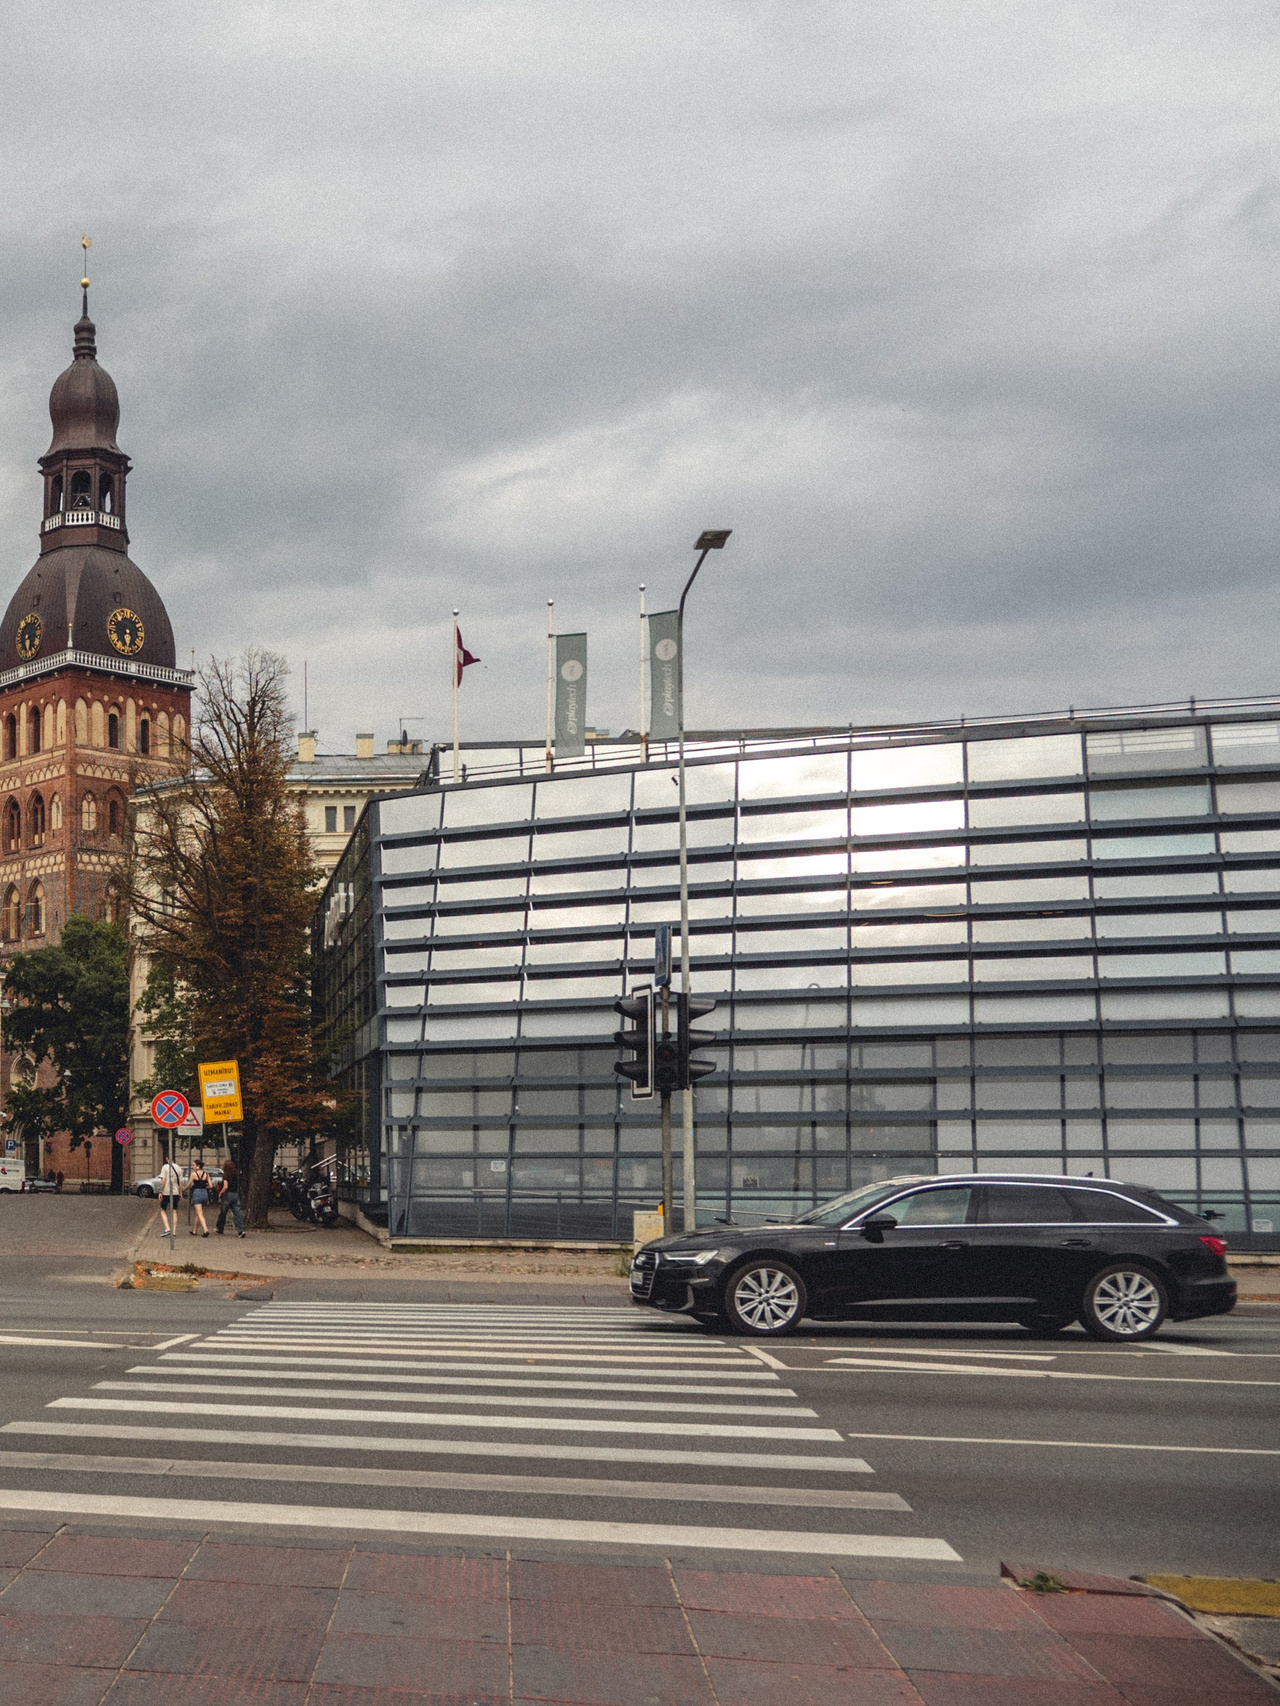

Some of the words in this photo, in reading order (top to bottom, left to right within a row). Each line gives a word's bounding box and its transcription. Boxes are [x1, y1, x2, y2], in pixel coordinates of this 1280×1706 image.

[661, 664, 674, 702] playtech
[566, 684, 578, 721] playtech
[7, 1141, 14, 1149] P
